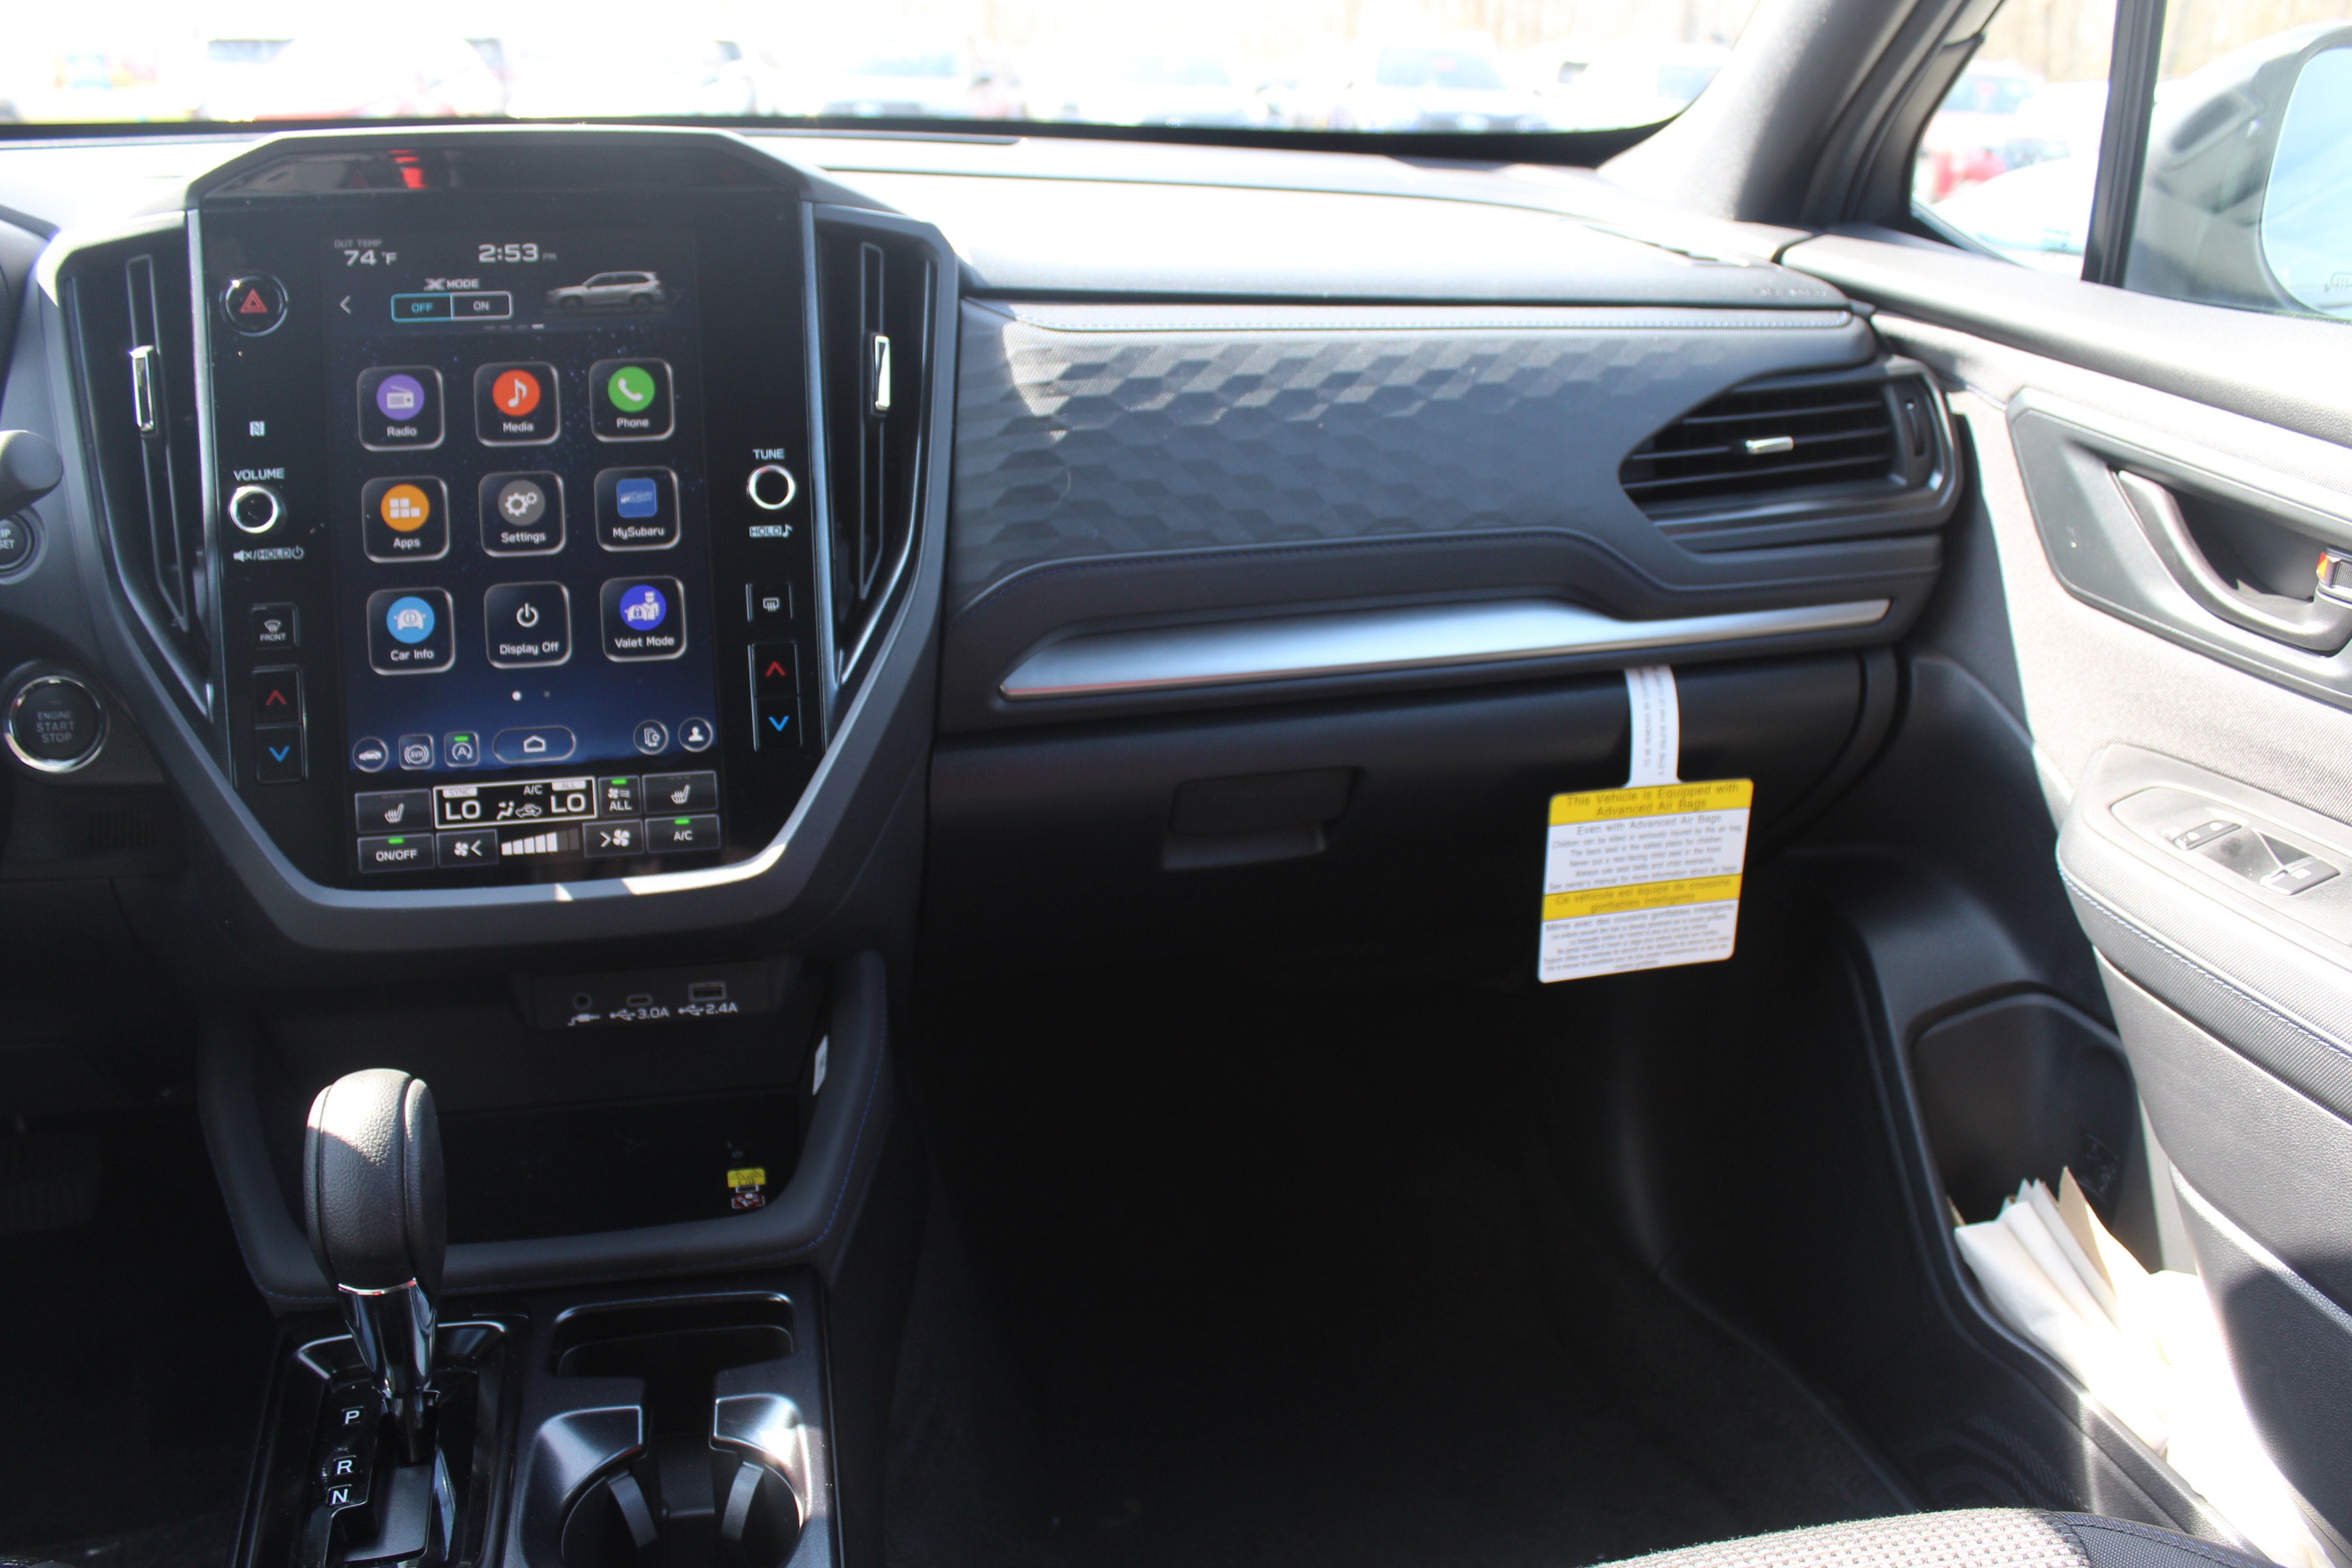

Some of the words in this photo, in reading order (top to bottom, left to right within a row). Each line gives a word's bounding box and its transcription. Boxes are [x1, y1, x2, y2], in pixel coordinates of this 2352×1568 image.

[333, 239, 353, 248] OUT
[357, 238, 382, 248] TEMP
[344, 249, 377, 267] 74
[478, 243, 539, 263] 2:53
[412, 302, 434, 313] OFF
[473, 301, 489, 312] ON
[503, 421, 534, 434] Media
[617, 417, 649, 429] Phone
[387, 425, 417, 438] Radio
[753, 448, 785, 460] TUNE
[233, 467, 284, 481] VOLUME
[501, 531, 545, 544] Settings
[612, 525, 665, 539] MySubaru
[750, 526, 782, 537] HOLD
[393, 536, 420, 549] Apps
[260, 632, 287, 642] FRONT
[615, 636, 642, 649] Valet
[646, 635, 674, 647] Mode
[391, 649, 410, 661] Car
[414, 648, 434, 659] Info
[500, 642, 539, 656] Display
[542, 641, 559, 653] Off
[37, 711, 71, 721] ENGINE
[36, 722, 74, 733] START
[42, 733, 73, 744] STOP
[523, 784, 543, 796] A/C
[1568, 796, 1590, 808] This
[1597, 790, 1637, 804] Vehicle
[1644, 789, 1652, 800] is
[1658, 784, 1710, 800] Equipped
[1716, 782, 1738, 794] with
[551, 793, 585, 813] LO
[609, 800, 632, 812] ALL
[1596, 802, 1652, 818] Advanced
[1659, 800, 1672, 811] Air
[1679, 797, 1707, 811] Bags
[446, 800, 480, 820] LO
[1578, 825, 1601, 835] Even
[1607, 822, 1624, 832] with
[1630, 817, 1676, 829] Advanced
[1682, 815, 1693, 823] Air
[1699, 813, 1721, 824] Bags
[674, 830, 693, 842] A/C
[376, 849, 417, 862] ON/OFF
[637, 1007, 670, 1019] 3.0A
[705, 1002, 738, 1015] 2.4A
[345, 1410, 359, 1424] P
[337, 1460, 353, 1475] R
[331, 1489, 348, 1505] N
